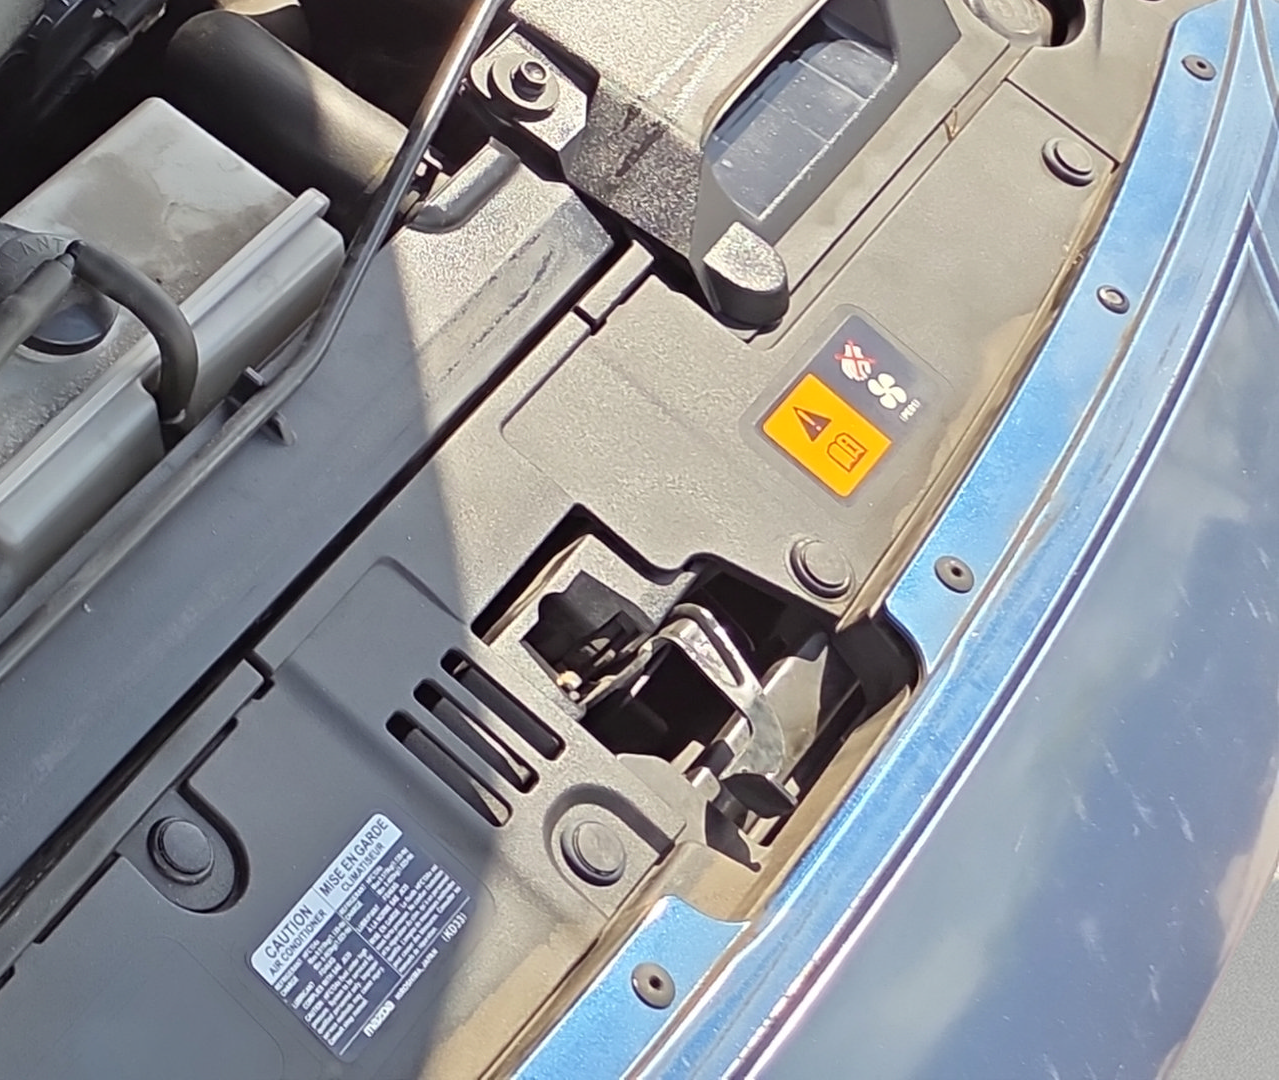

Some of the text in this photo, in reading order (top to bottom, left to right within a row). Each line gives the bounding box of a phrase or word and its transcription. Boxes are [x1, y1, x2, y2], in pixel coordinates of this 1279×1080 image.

[317, 866, 346, 897] MISE
[339, 852, 358, 871] EN
[351, 817, 388, 857] GARDE
[339, 841, 385, 892] CLIMATISEUR
[262, 904, 313, 960] CAUTION
[267, 908, 328, 976] AIR CONDITIONER
[439, 911, 468, 943] (KD33)
